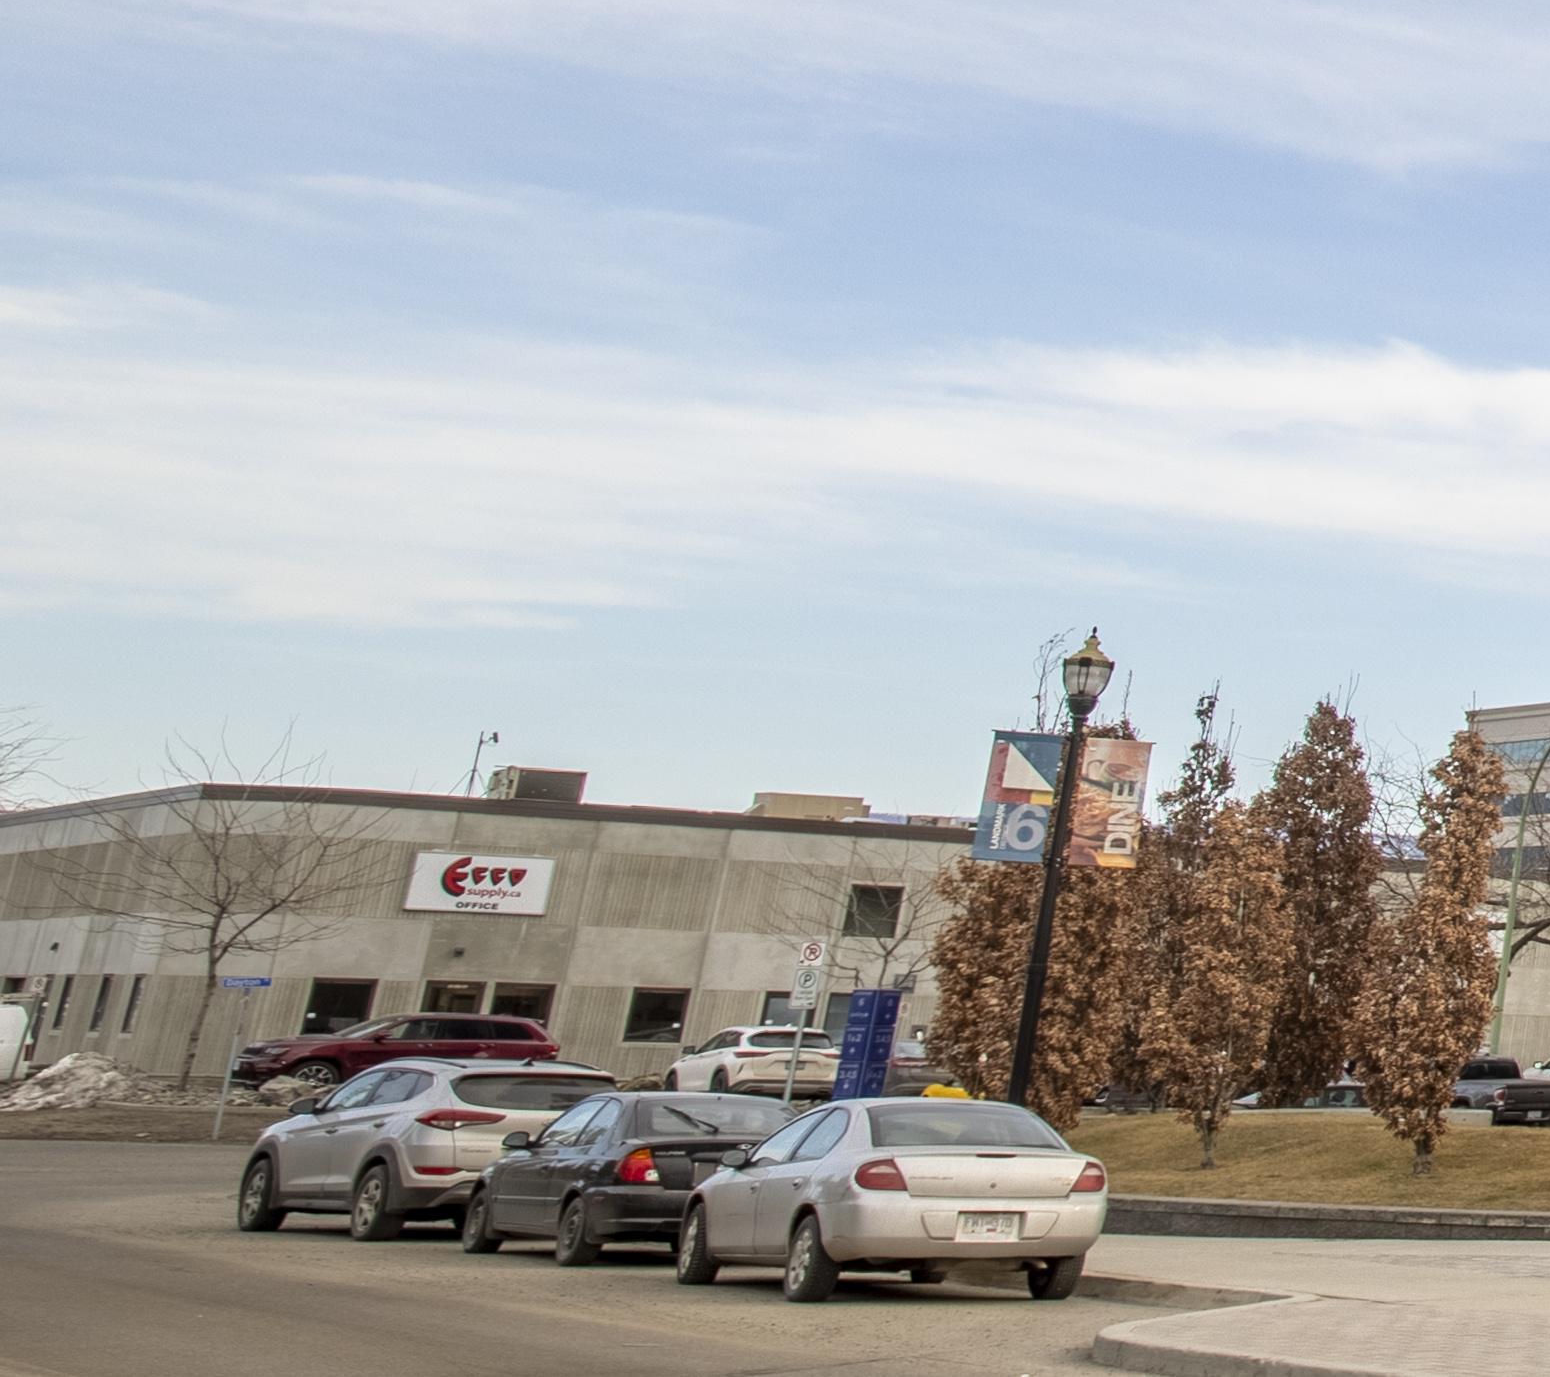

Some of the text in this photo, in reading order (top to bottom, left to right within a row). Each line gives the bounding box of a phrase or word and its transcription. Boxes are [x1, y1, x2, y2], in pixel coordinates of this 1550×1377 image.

[989, 803, 1007, 850] LANDMARK
[1006, 804, 1048, 851] 6
[1104, 781, 1141, 855] DINE
[456, 901, 499, 910] OFFICE
[467, 887, 521, 899] supply.ca
